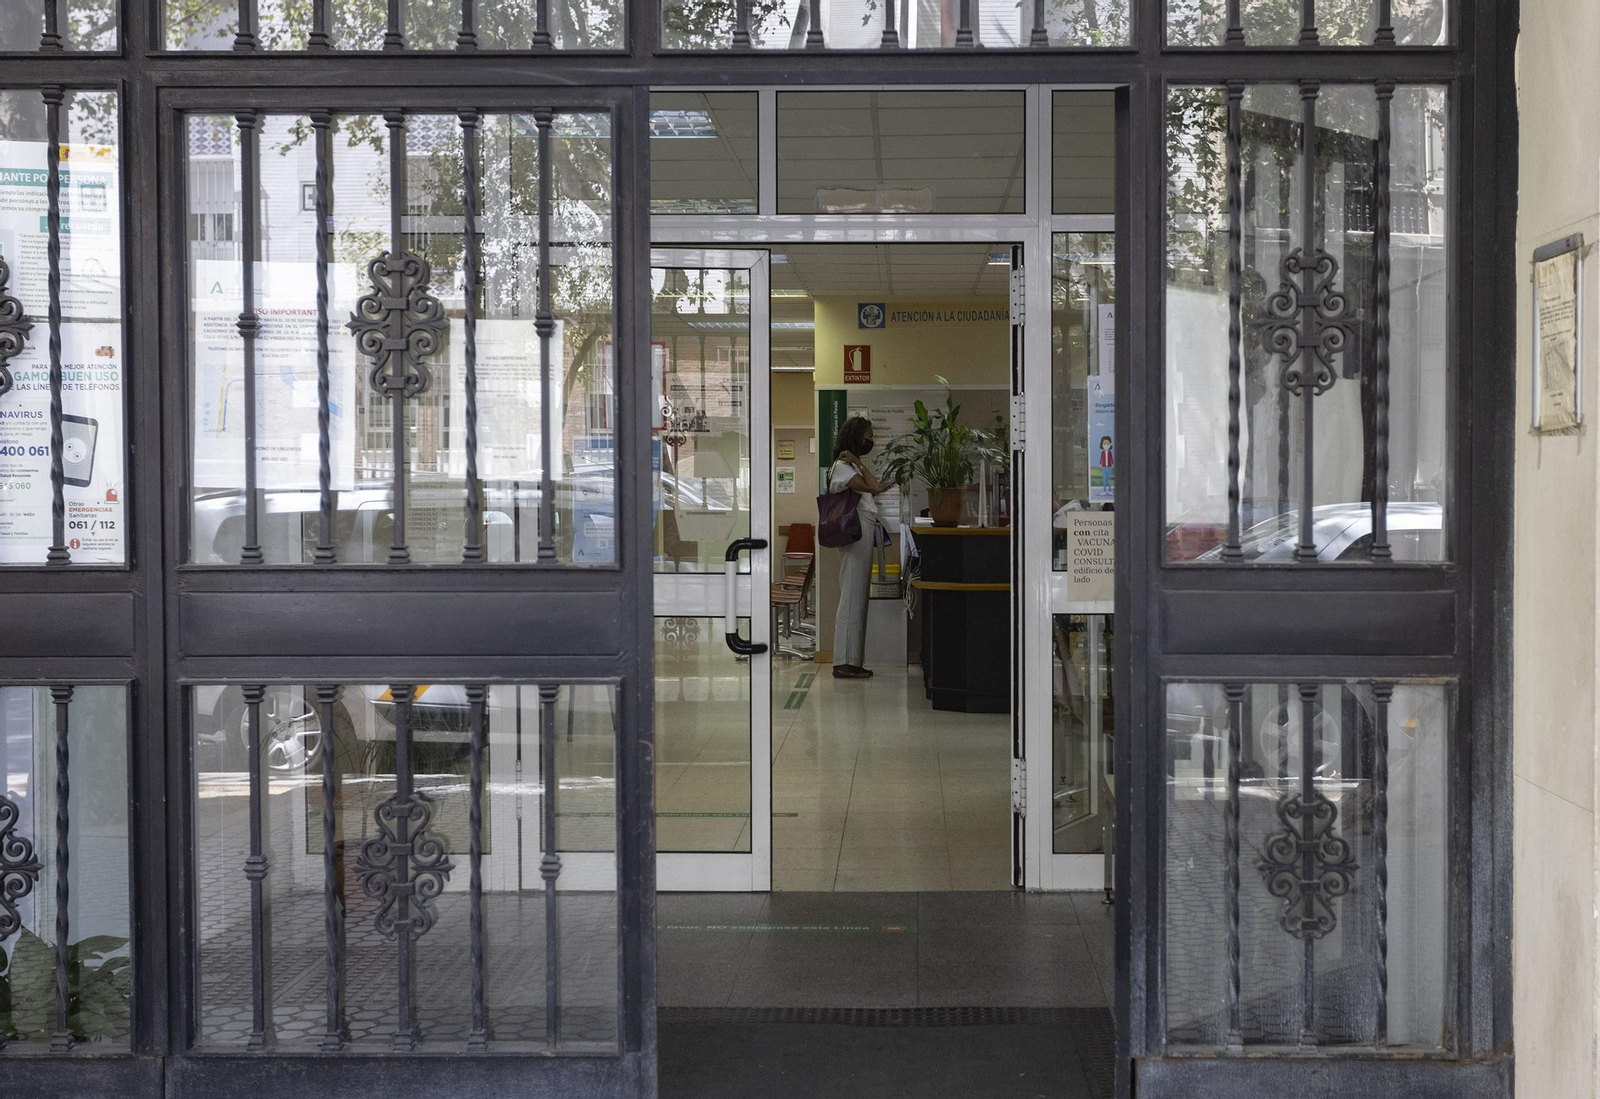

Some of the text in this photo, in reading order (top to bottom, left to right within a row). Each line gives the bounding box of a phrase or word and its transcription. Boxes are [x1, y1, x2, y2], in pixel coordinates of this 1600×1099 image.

[33, 174, 48, 183] PO
[61, 222, 107, 231] recuerde:
[890, 308, 1010, 322] ATENCIÓN A LA CIUDADANÍA
[13, 371, 49, 382] GAMO
[95, 371, 119, 381] USO
[33, 381, 51, 390] LÍNE
[75, 382, 120, 391] TELÉFONOS
[0, 411, 43, 419] NAVIRUS
[28, 446, 50, 456] 061
[15, 482, 31, 490] 060
[68, 521, 88, 530] 061
[99, 521, 115, 529] 112
[1073, 519, 1113, 527] Personas
[1093, 529, 1109, 537] cita
[1073, 558, 1115, 566] CONSULT
